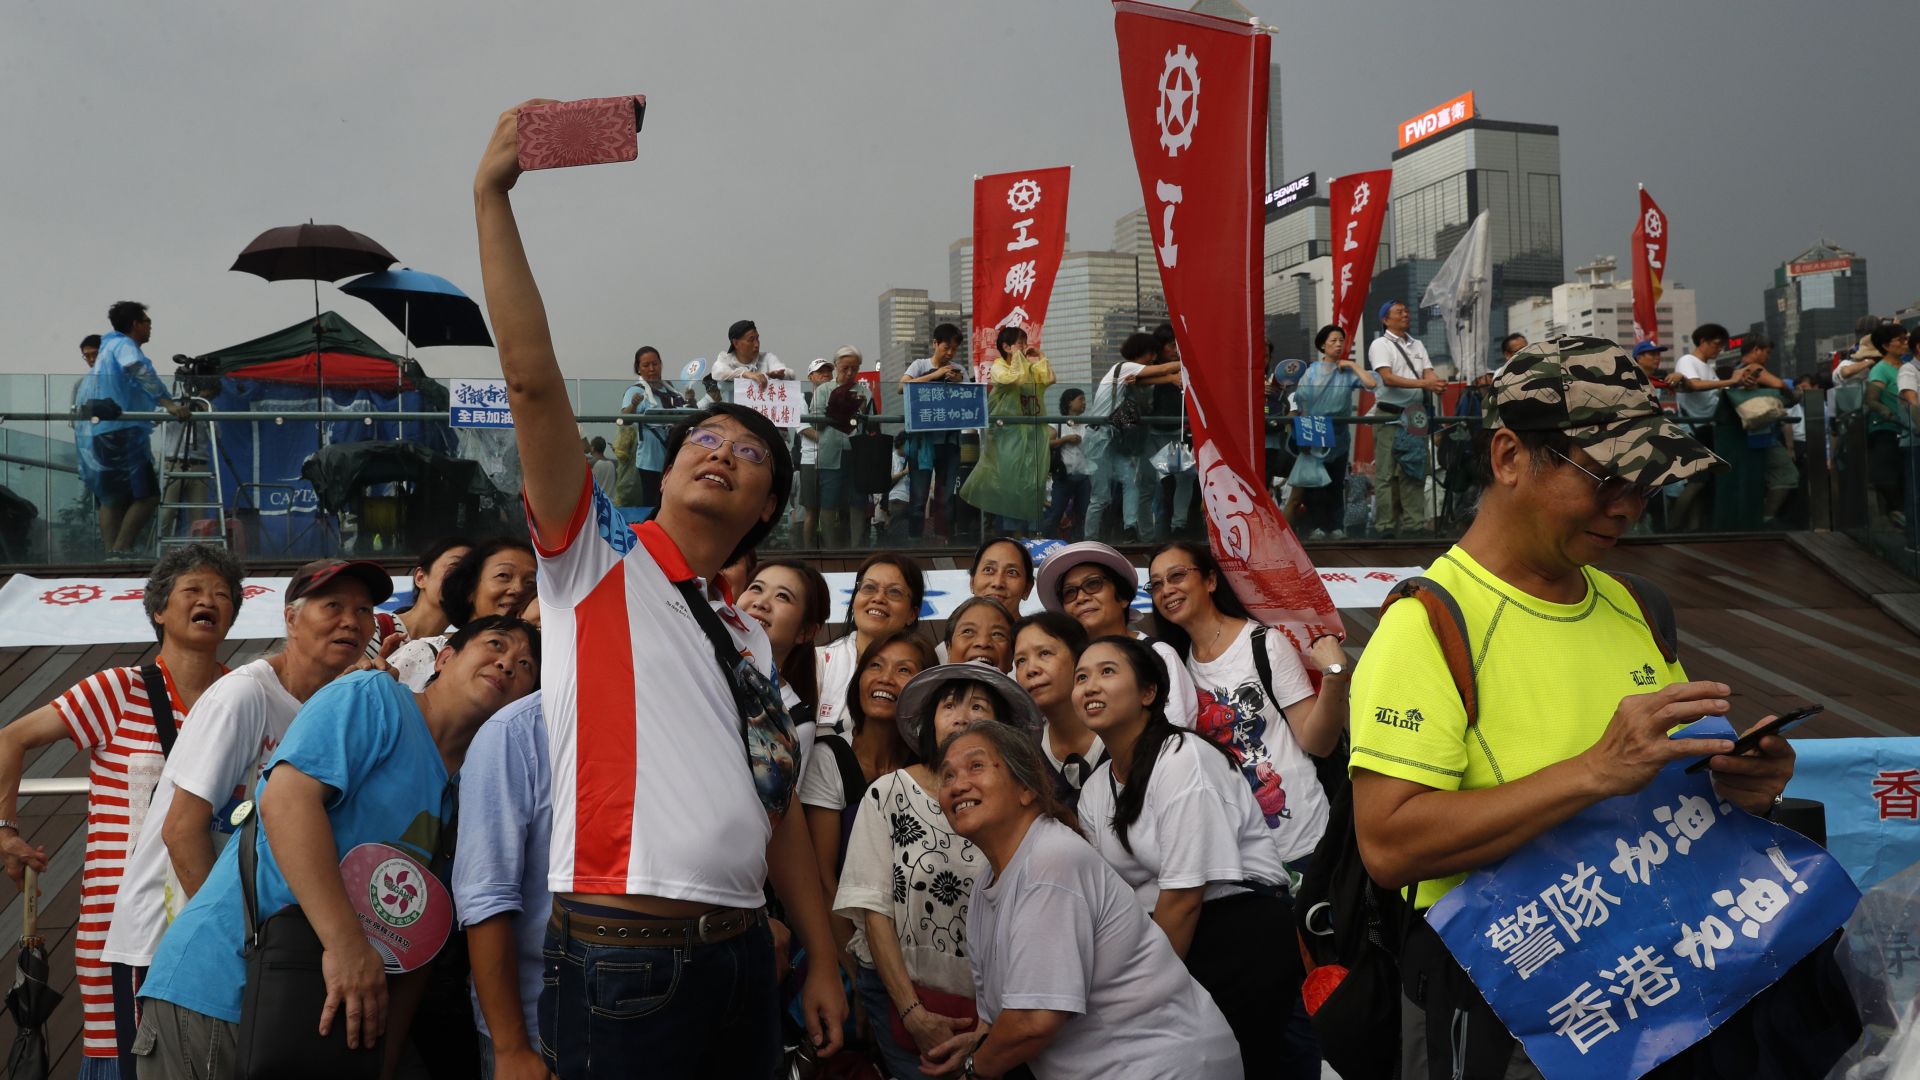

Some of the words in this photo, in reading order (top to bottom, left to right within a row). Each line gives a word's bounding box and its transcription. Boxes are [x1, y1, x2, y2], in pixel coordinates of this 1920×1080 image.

[1405, 114, 1437, 144] FWD
[1273, 176, 1310, 201] SIGNATURE
[746, 382, 787, 402] 我愛香港
[457, 409, 514, 424] 全民加油
[1630, 670, 1657, 686] Lion
[1375, 706, 1421, 732] Lion
[1546, 847, 1809, 1056] 香港加油!
